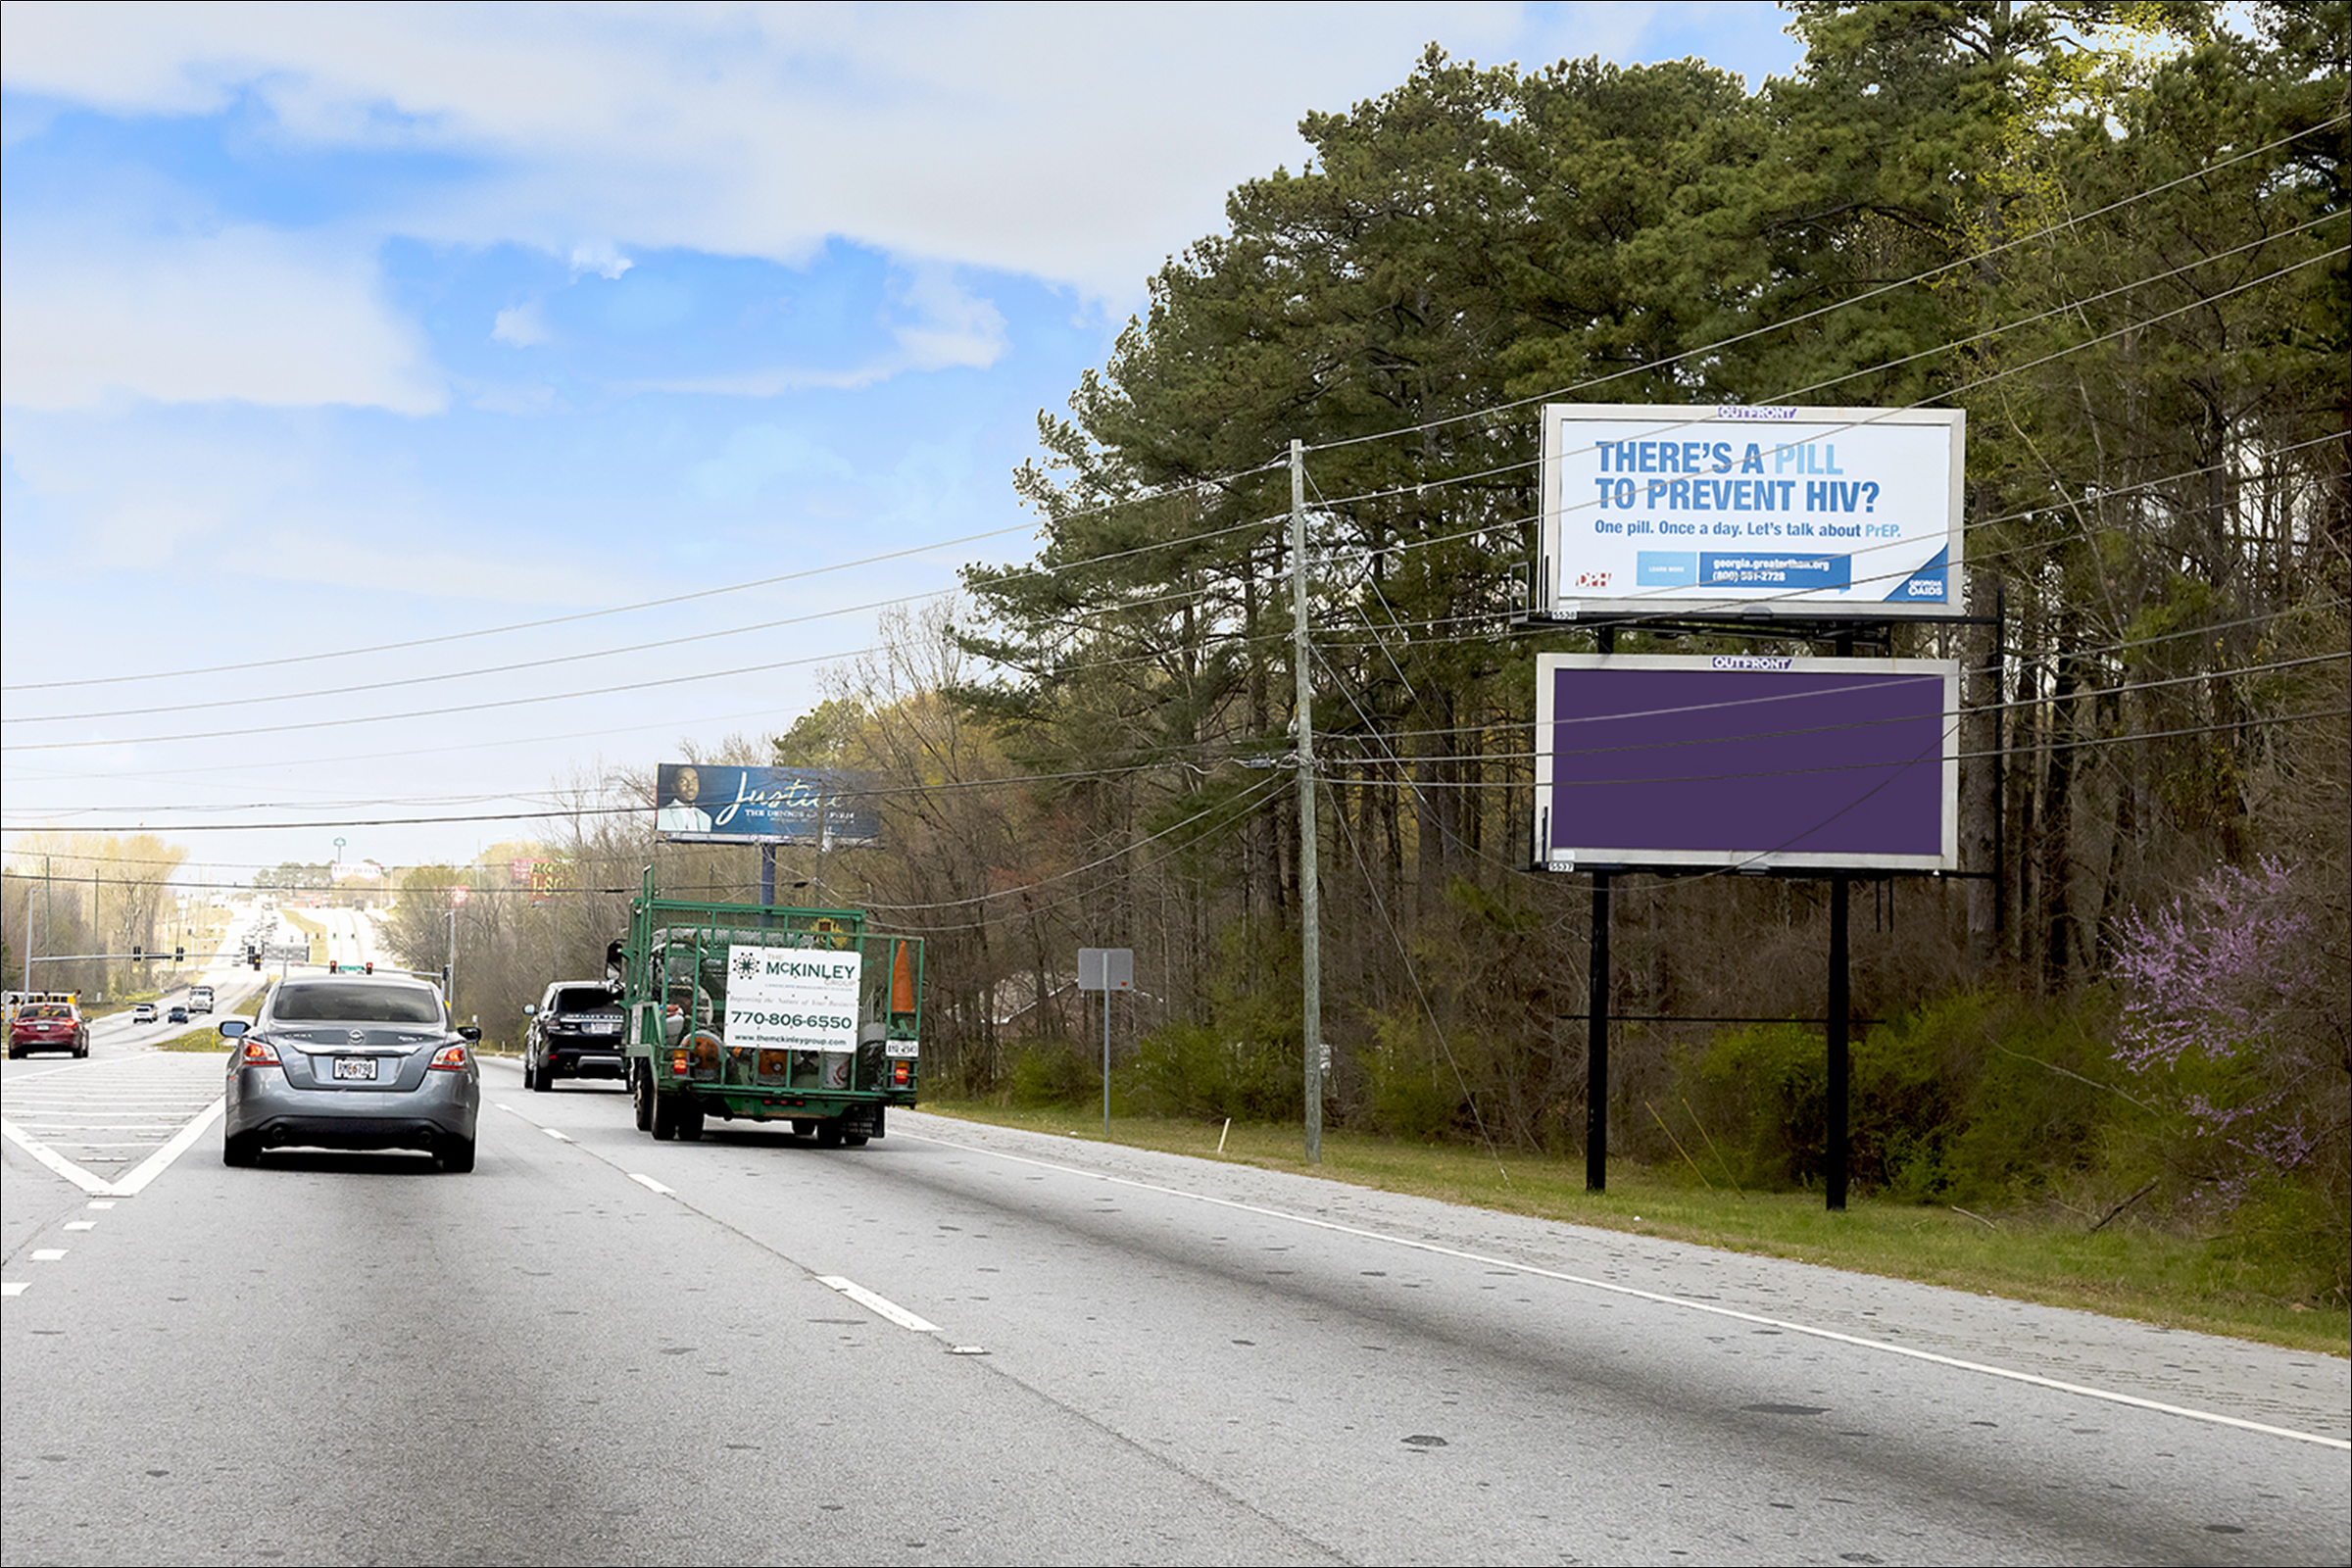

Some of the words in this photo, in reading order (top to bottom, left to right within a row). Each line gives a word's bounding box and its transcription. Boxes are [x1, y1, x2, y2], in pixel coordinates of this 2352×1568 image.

[1719, 406, 1796, 418] OUTFRONT
[1595, 441, 1732, 473] THERE'S
[1740, 443, 1764, 474] A
[1775, 443, 1843, 475] PILL
[1594, 477, 1636, 510] TO
[1646, 478, 1795, 512] PREVENT
[1806, 480, 1881, 513] HIV?
[1594, 519, 1623, 534] One
[1627, 520, 1654, 536] pill.
[1659, 520, 1695, 535] Once
[1699, 524, 1708, 535] a
[1712, 521, 1742, 538] day.
[1747, 522, 1782, 537] Let's
[1786, 522, 1814, 537] talk
[1819, 523, 1861, 538] about
[1865, 524, 1901, 538] PrEP.
[1713, 657, 1792, 670] OUTFRONT
[731, 1010, 853, 1030] 770-806-6550
